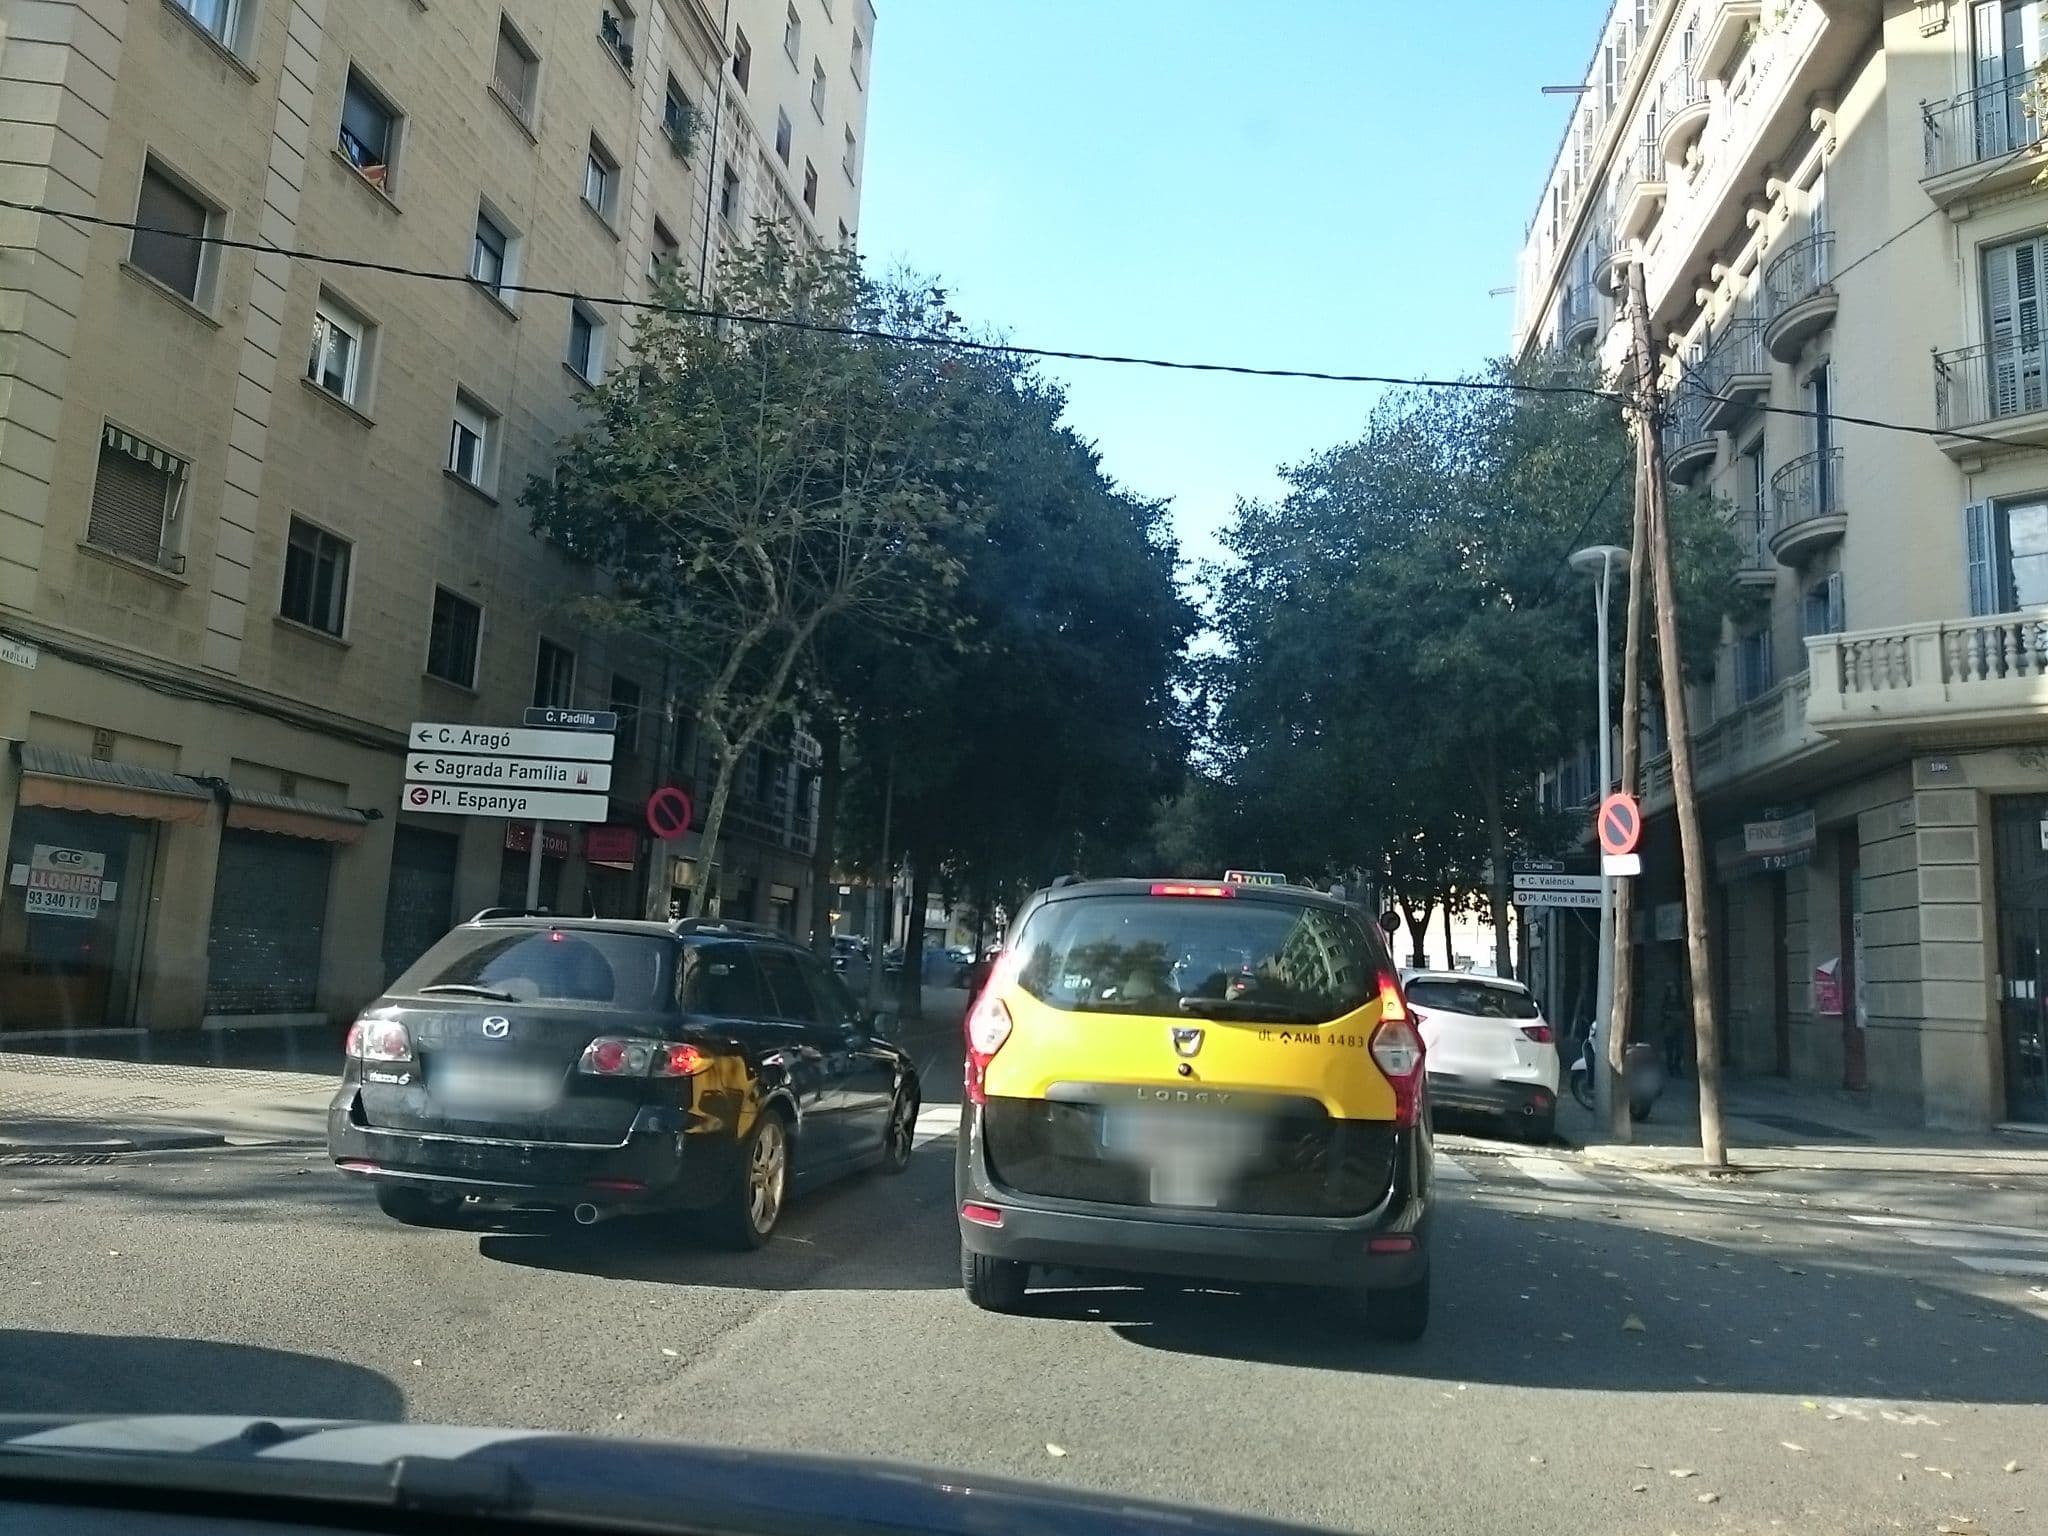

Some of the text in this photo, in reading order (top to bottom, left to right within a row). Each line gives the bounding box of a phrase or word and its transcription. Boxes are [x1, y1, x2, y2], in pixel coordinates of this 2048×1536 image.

[545, 711, 595, 725] C. Padilla
[438, 728, 511, 750] C. Aragó
[434, 759, 567, 781] Sagrada Família
[431, 790, 527, 811] Pl. Espanya
[1528, 878, 1537, 886] C.
[29, 891, 42, 904] 93
[45, 893, 65, 908] 340
[1528, 894, 1538, 902] Pl.
[1541, 894, 1567, 903] Alfons
[1294, 1033, 1321, 1045] AMB
[1327, 1034, 1364, 1049] 4483
[1136, 1087, 1233, 1104] LODGY
